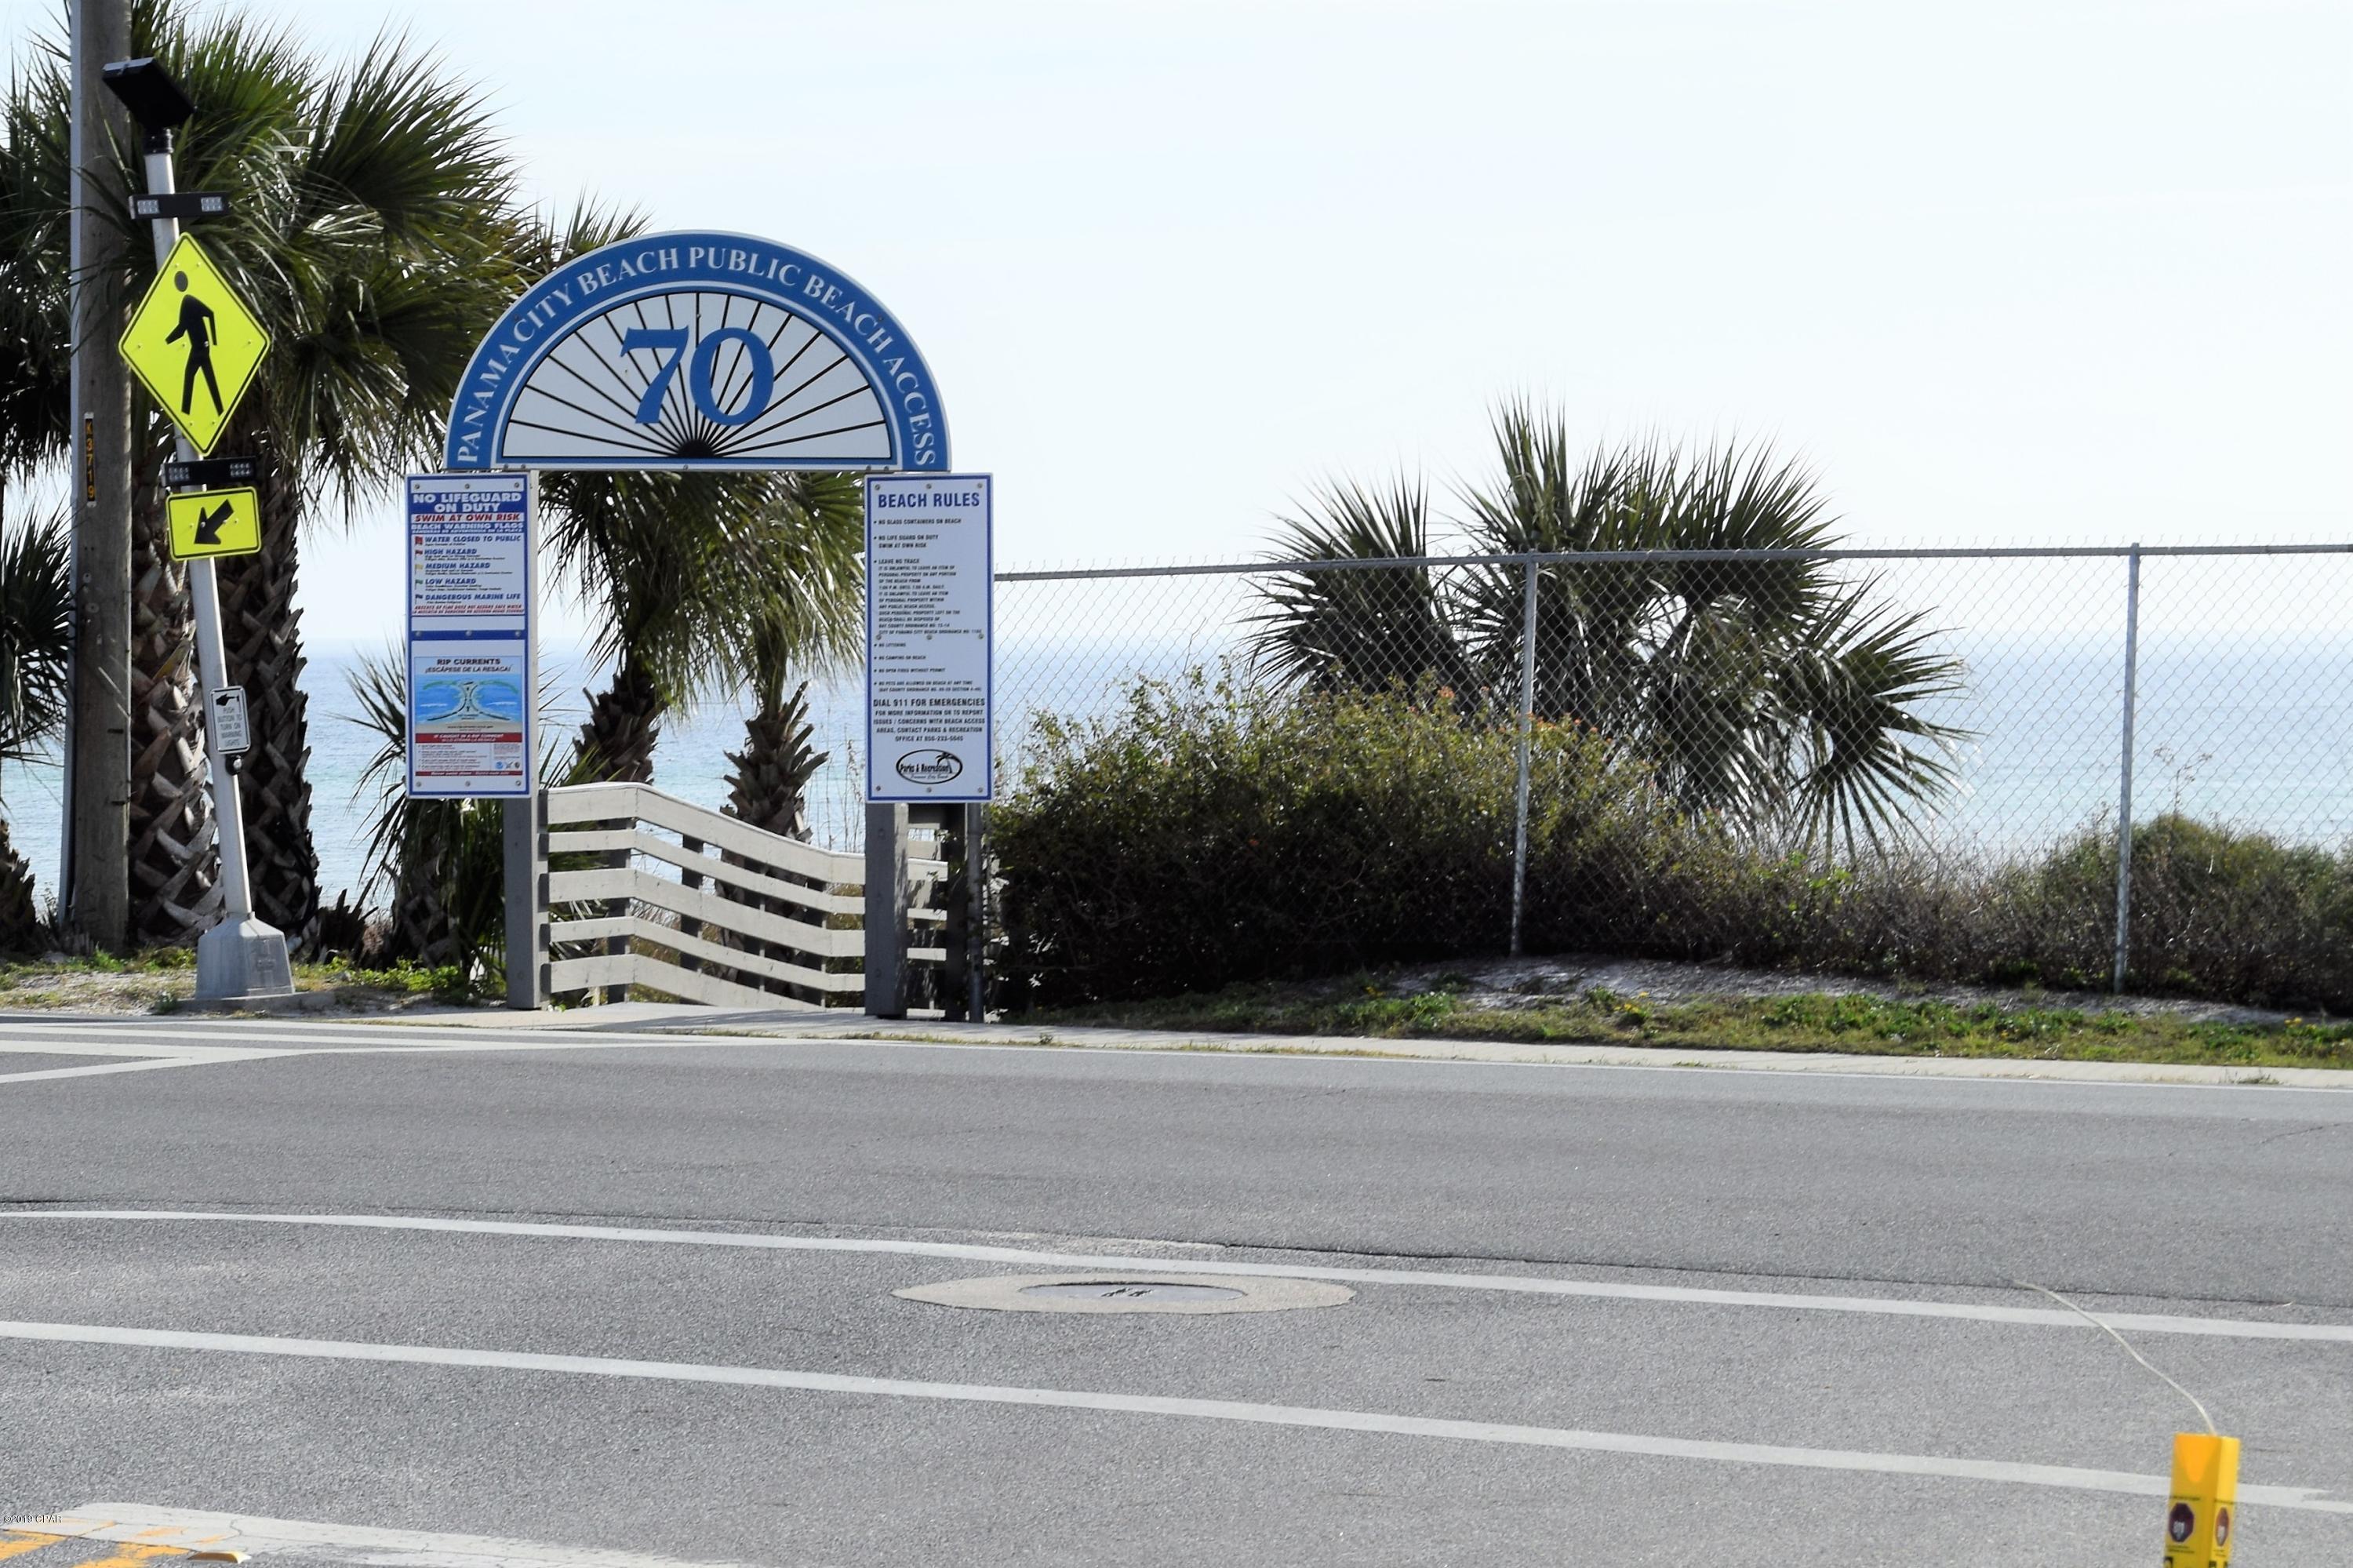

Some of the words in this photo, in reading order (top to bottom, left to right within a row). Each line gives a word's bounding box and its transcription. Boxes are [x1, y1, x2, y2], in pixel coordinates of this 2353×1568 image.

[457, 343, 521, 462] PANAMA
[513, 283, 574, 343] CITY
[577, 247, 678, 296] BEACH
[689, 247, 801, 286] PUBLIC
[802, 274, 893, 353] BEACH
[883, 357, 936, 466] ACCESS
[620, 325, 774, 426] 70
[413, 494, 436, 504] NO
[441, 493, 522, 503] LIFEGUARD
[878, 493, 927, 508] BEACH
[933, 493, 979, 507] RULES
[435, 503, 457, 512] ON
[462, 502, 500, 512] DUTY
